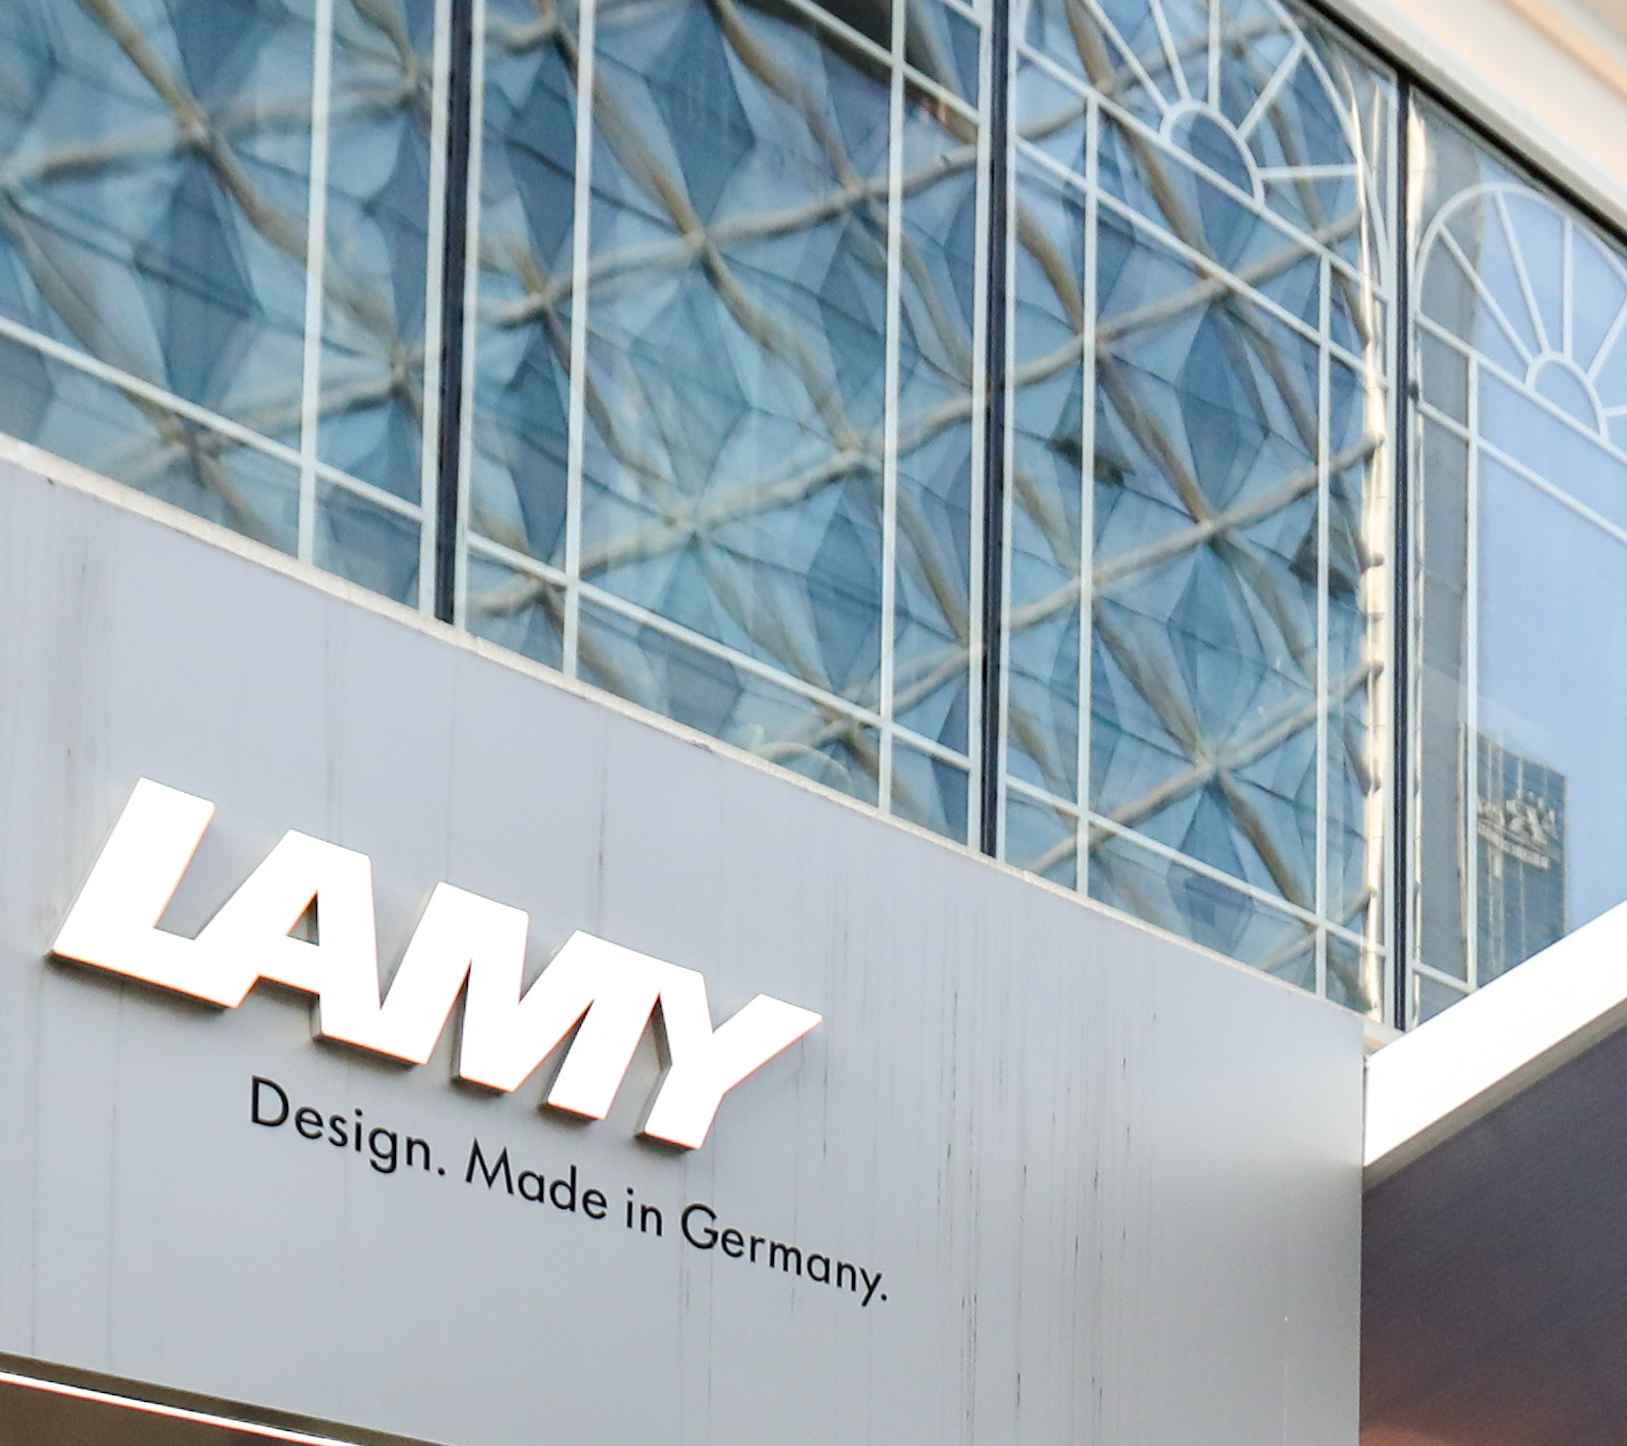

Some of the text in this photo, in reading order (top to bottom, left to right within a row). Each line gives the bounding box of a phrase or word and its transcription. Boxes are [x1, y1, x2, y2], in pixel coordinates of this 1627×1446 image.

[46, 776, 823, 1151] LAMY
[249, 1075, 891, 1308] Design. Made in Germany.
